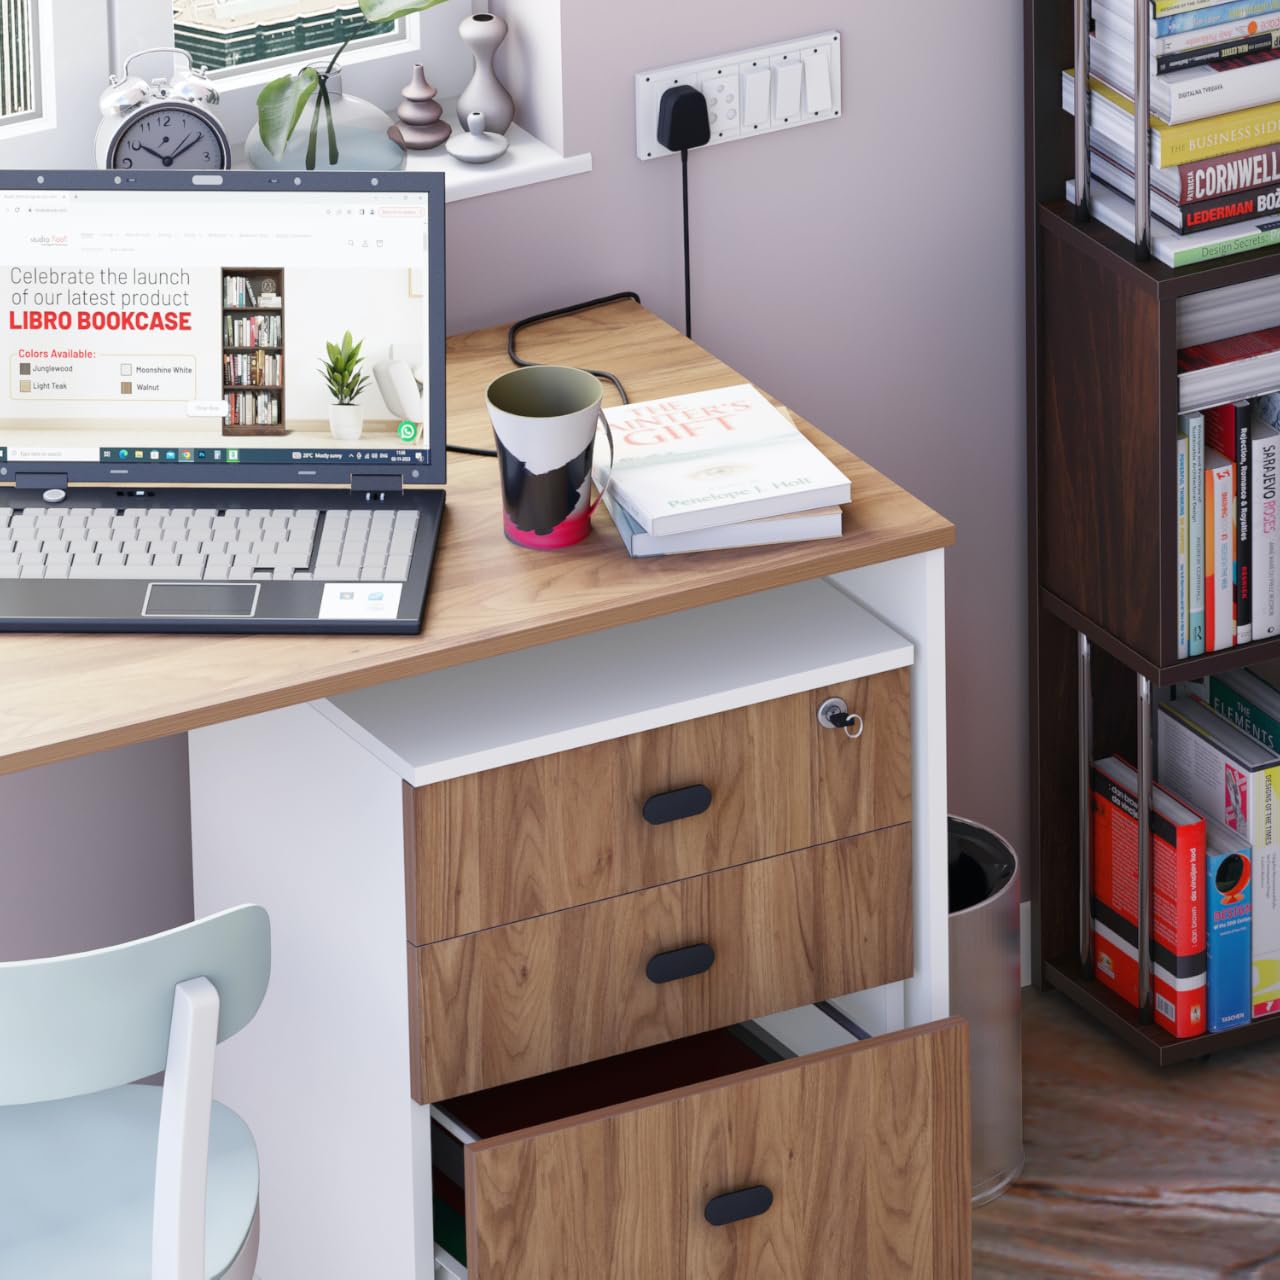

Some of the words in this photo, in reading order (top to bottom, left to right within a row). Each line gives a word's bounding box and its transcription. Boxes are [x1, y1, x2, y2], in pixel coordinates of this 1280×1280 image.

[140, 122, 151, 133] 11
[157, 116, 171, 127] 12
[1188, 128, 1252, 152] BUSINESS
[1186, 170, 1194, 201] PATRICIA
[1194, 151, 1280, 199] CORNWELL
[1185, 200, 1254, 227] LEDERMAN
[1201, 240, 1233, 258] Design
[11, 267, 95, 285] Celebrate
[100, 268, 128, 285] the
[133, 267, 190, 285] launch
[11, 288, 29, 306] of
[34, 292, 63, 306] our
[67, 289, 116, 306] latest
[121, 290, 189, 310] product
[9, 311, 72, 330] LIBRO
[77, 311, 192, 331] BOOKCASE
[18, 349, 49, 359] Colors
[51, 349, 97, 359] Available:
[32, 365, 73, 375] Junglewood
[135, 366, 172, 375] Moonshine
[173, 367, 193, 375] White
[33, 382, 51, 391] Light
[136, 384, 160, 392] Walnut
[631, 401, 682, 417] THE
[623, 417, 736, 447] GIFT
[1239, 427, 1248, 465] Rejection,
[1240, 465, 1248, 500] Romance
[1262, 445, 1276, 500] SARAJEVO
[1239, 507, 1248, 541] Royalties
[1262, 500, 1276, 534] ROSES
[1237, 702, 1251, 719] THE
[1214, 697, 1274, 749] ELEMENTS
